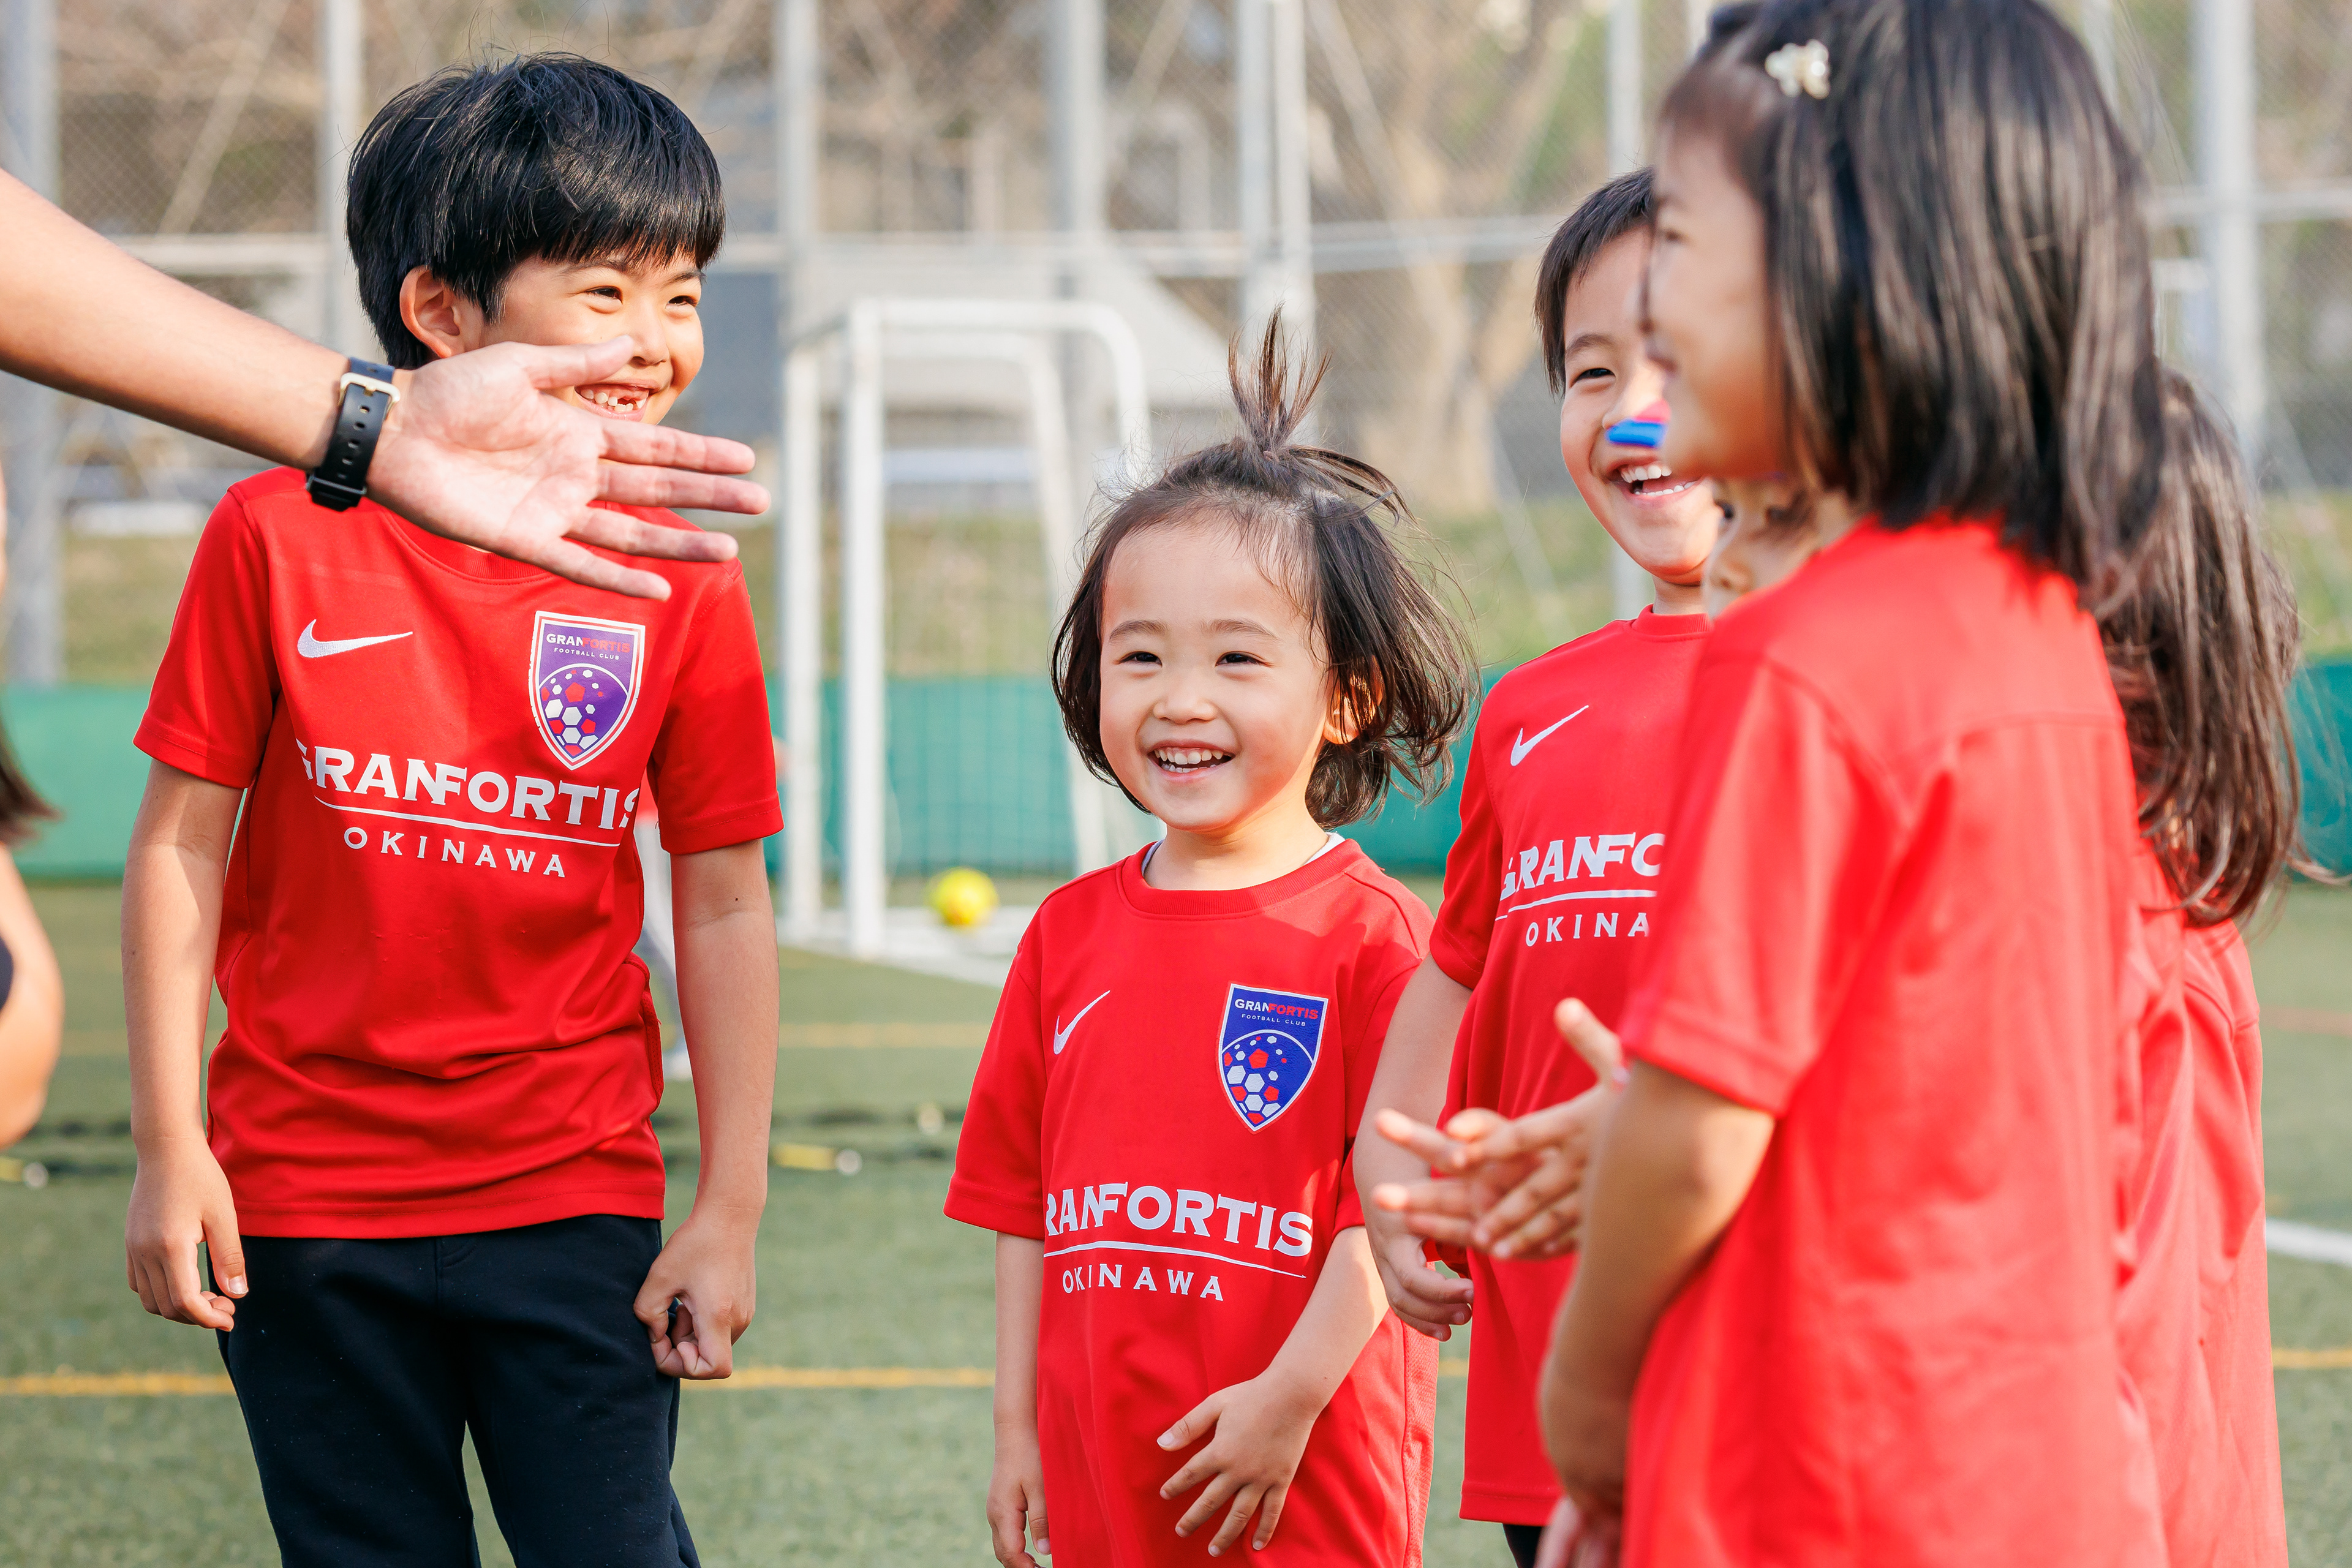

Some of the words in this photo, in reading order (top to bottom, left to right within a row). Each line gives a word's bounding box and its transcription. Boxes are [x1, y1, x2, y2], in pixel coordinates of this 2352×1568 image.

[546, 633, 630, 653] GRANFORTIS
[554, 647, 595, 657] FOOTBALL
[344, 827, 565, 878] OKINAWA
[1234, 998, 1318, 1019] GRANFORTIS
[1241, 1013, 1281, 1022] FOOTBALL
[1063, 1264, 1223, 1301] OKINAWA
